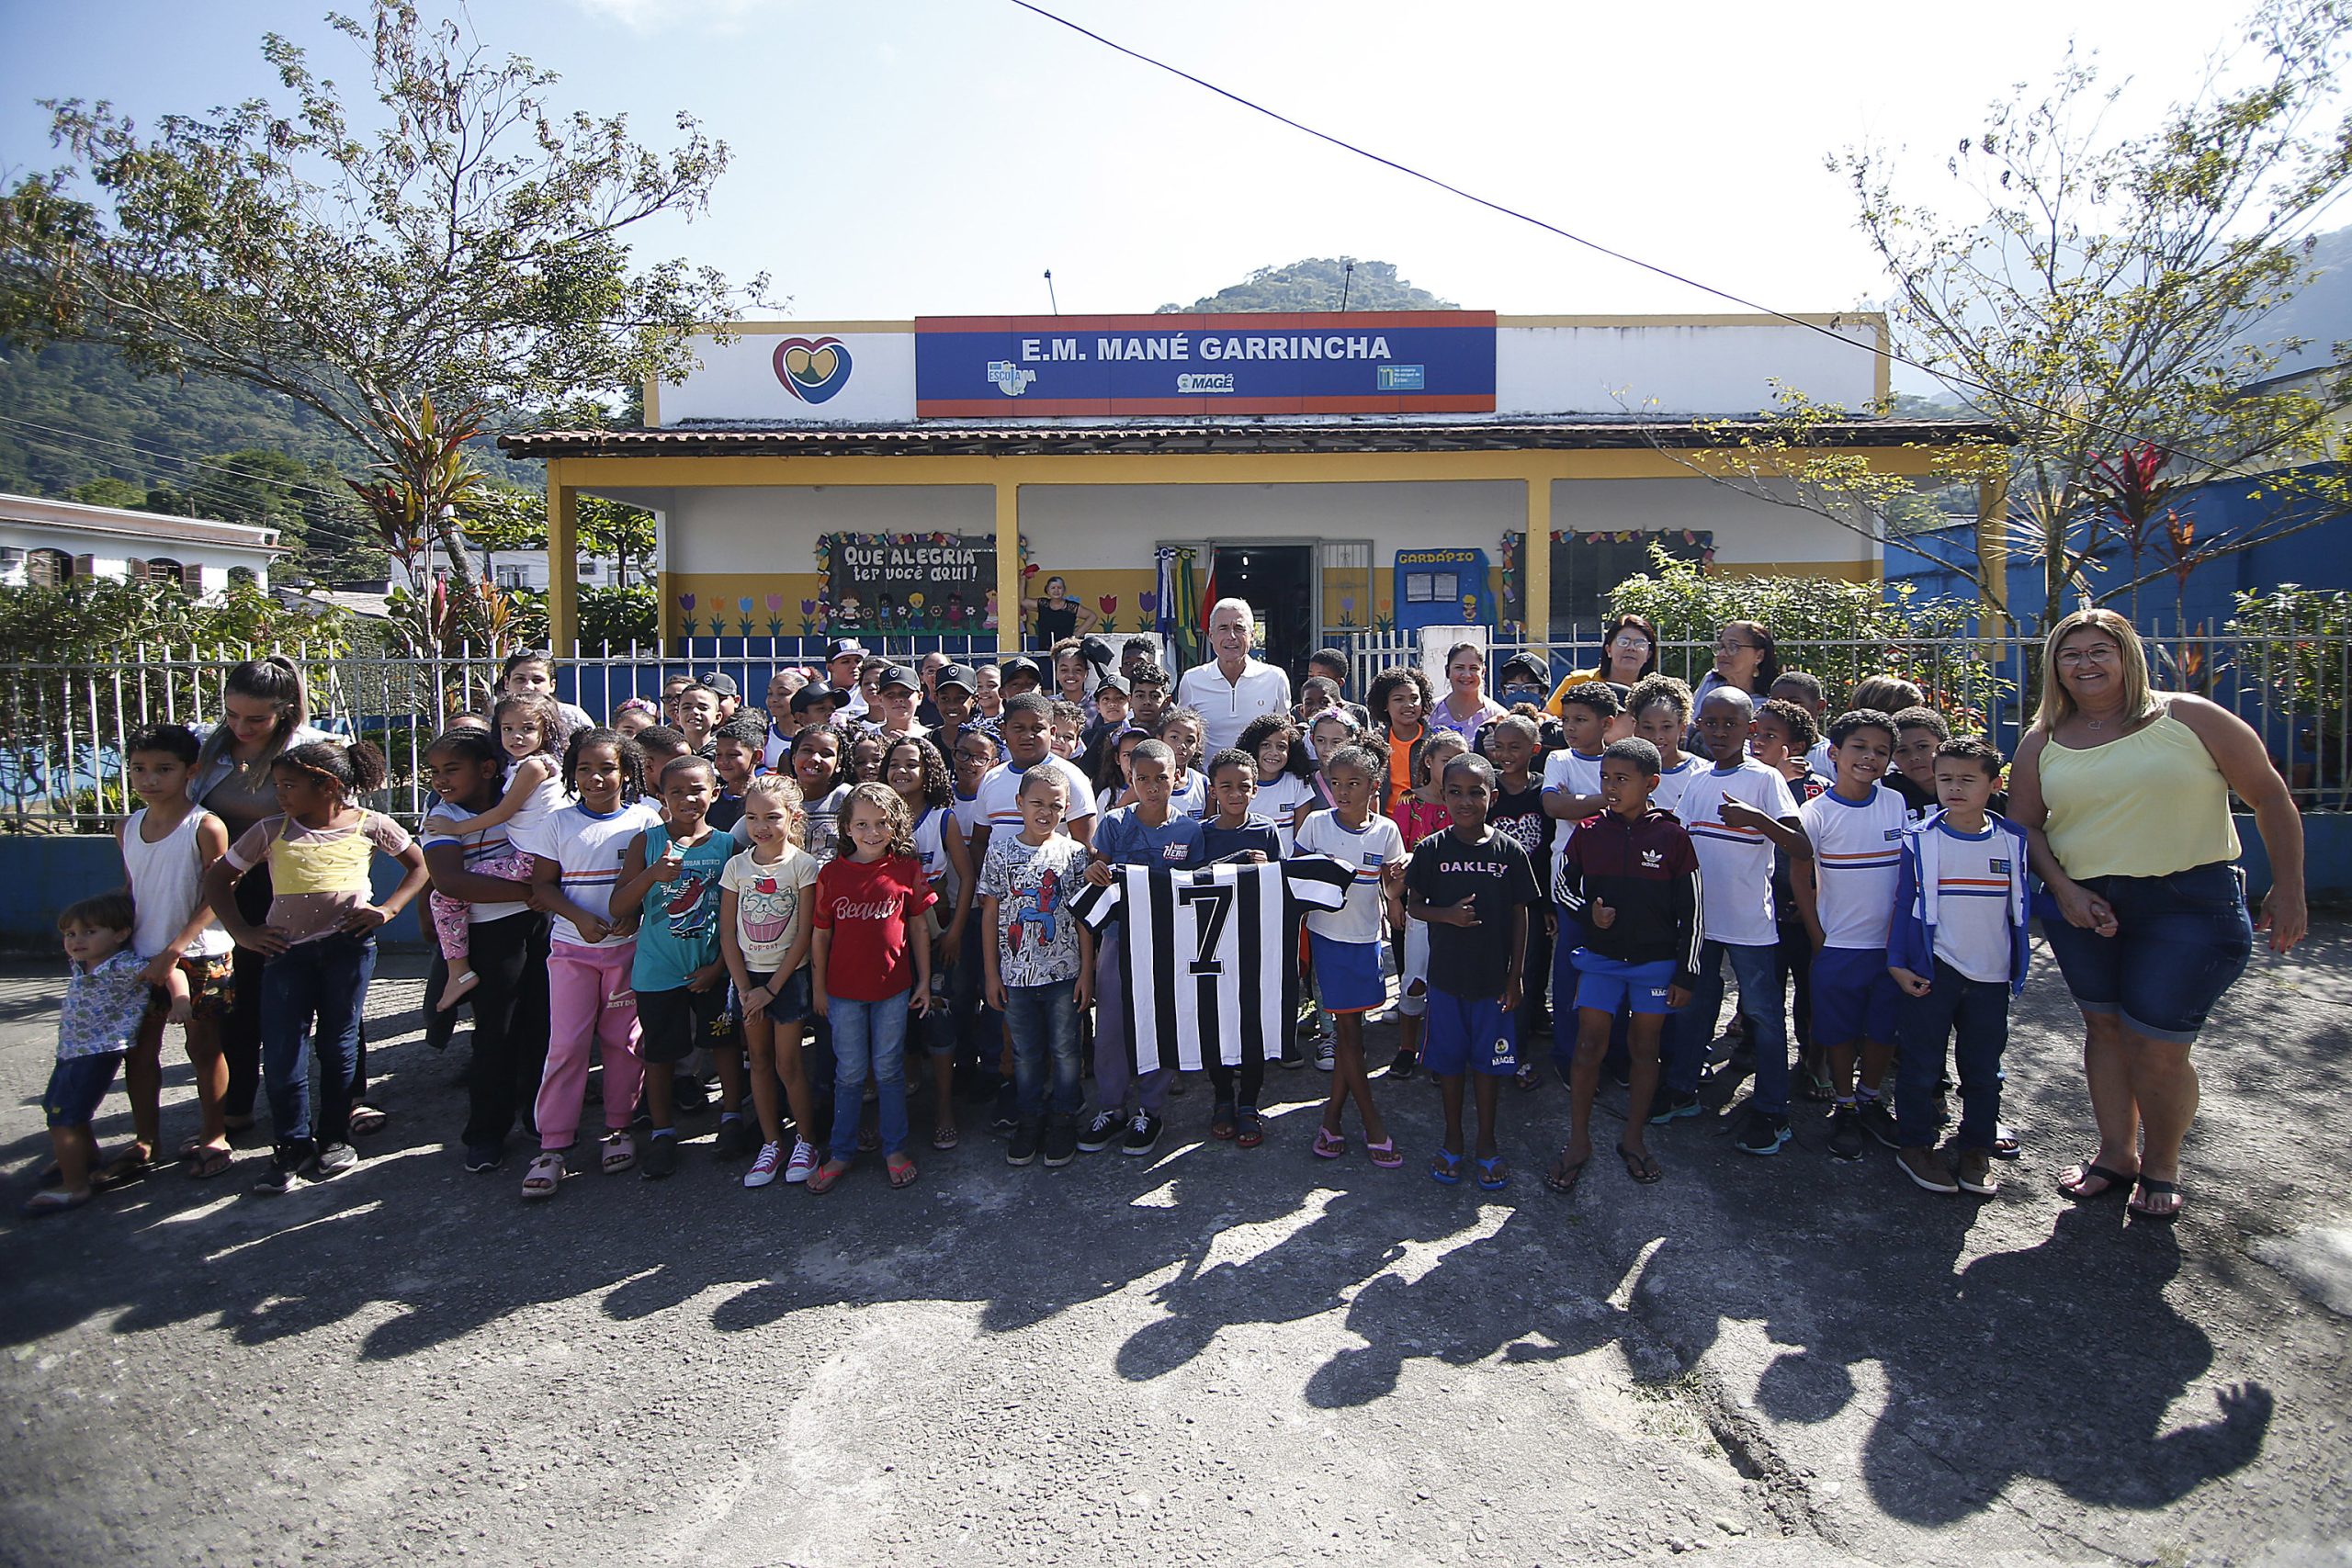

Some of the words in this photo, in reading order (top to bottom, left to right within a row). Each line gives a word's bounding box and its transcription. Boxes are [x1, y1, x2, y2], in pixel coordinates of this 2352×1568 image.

[1022, 339, 1086, 361] E.M.
[1097, 333, 1189, 360] MANÉ
[1199, 336, 1391, 360] GARRINCHA
[1192, 374, 1232, 389] MAGÉ
[844, 546, 884, 566] QUE
[890, 548, 976, 565] ALEGRIA
[854, 566, 879, 581] ter
[885, 565, 923, 581] você
[1440, 862, 1508, 874] OAKLEY
[1177, 884, 1235, 976] 7
[1491, 1055, 1515, 1066] MAGÉ
